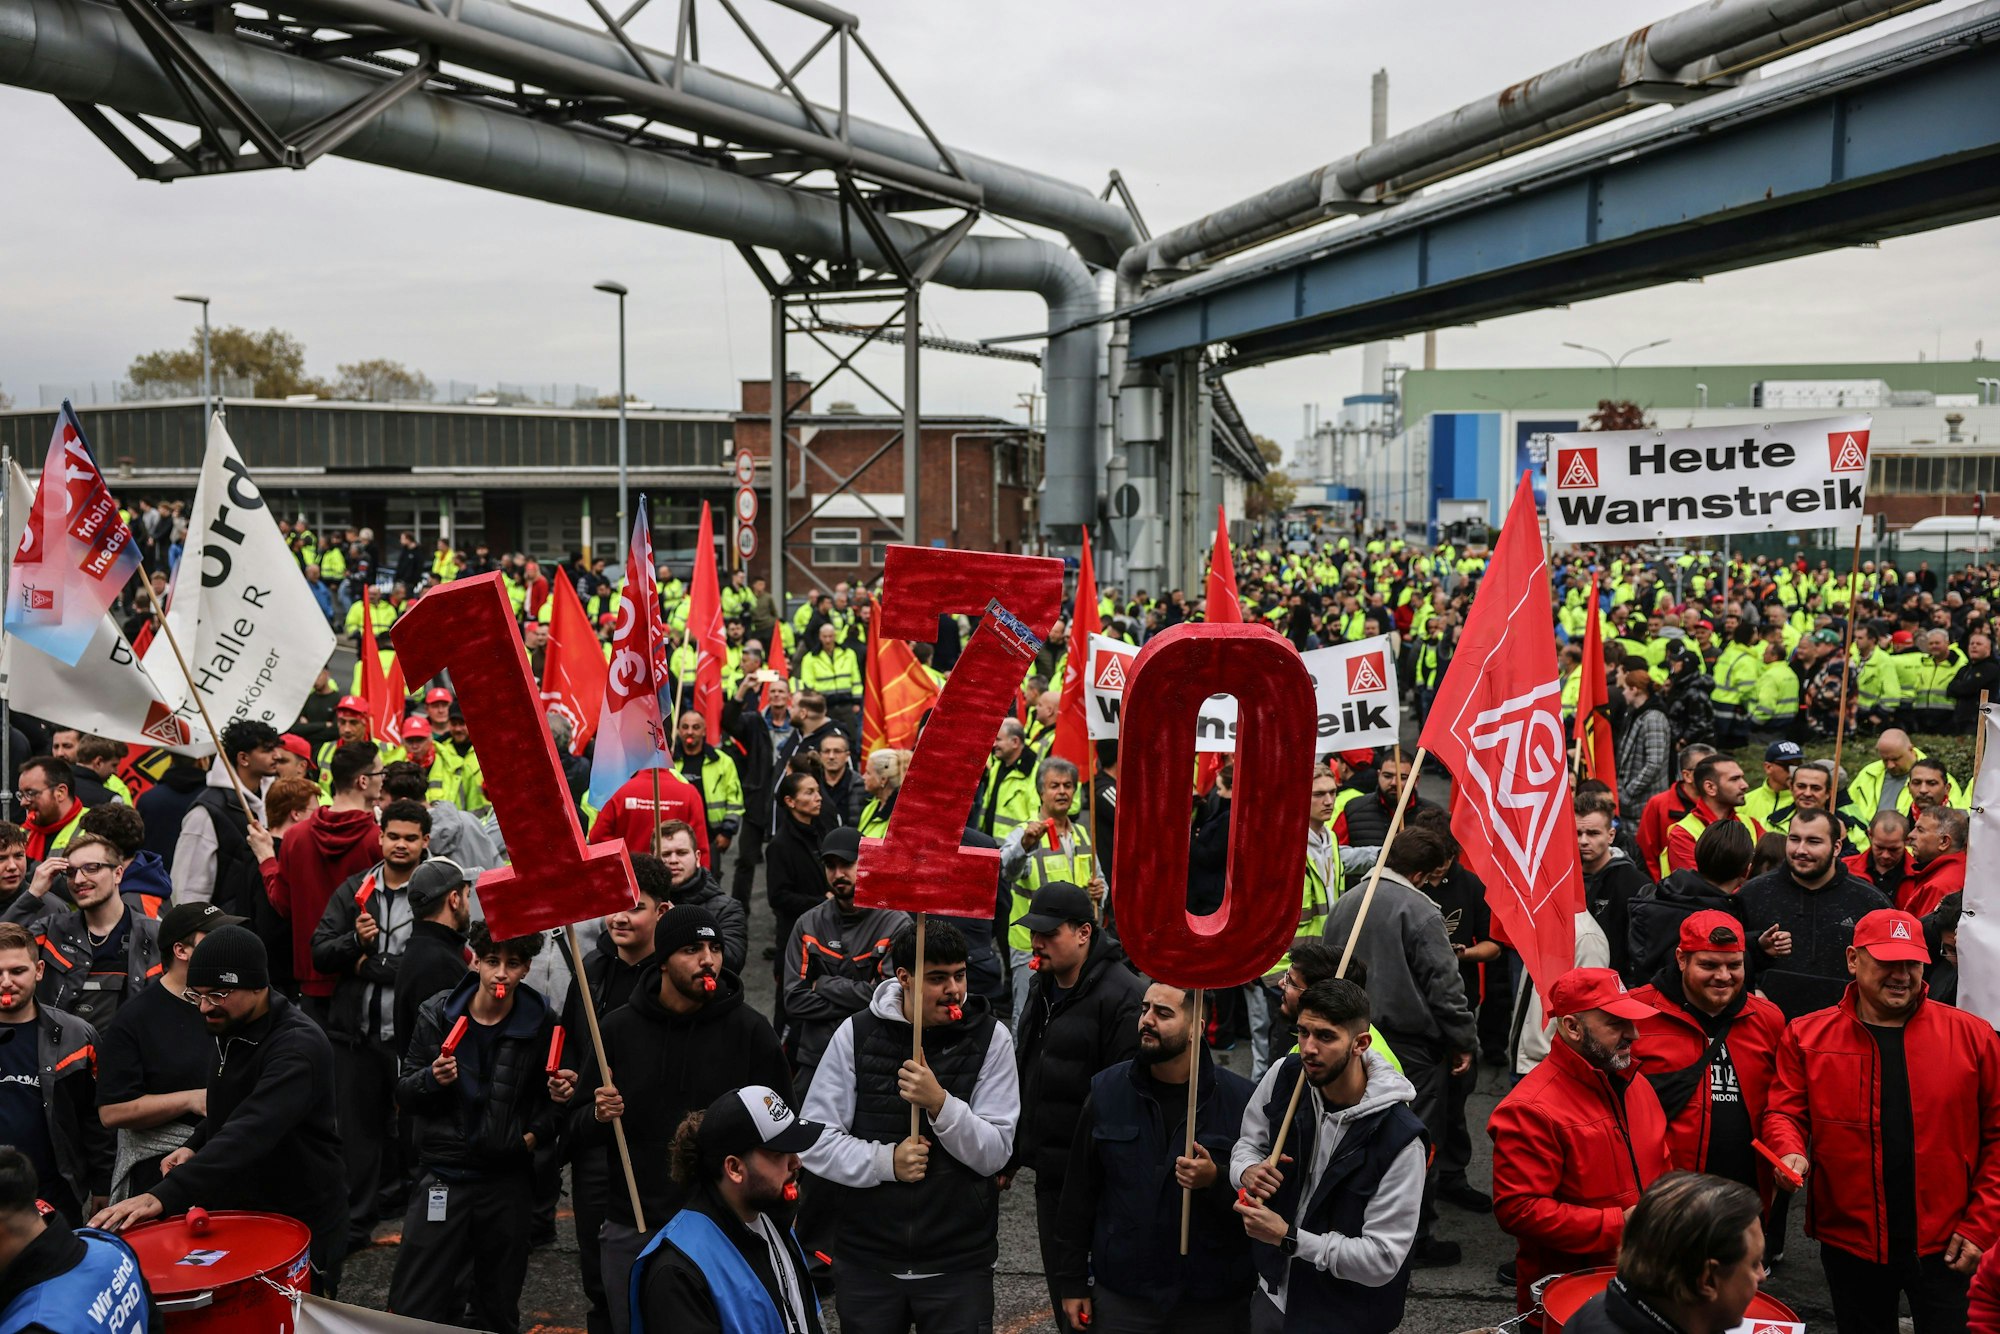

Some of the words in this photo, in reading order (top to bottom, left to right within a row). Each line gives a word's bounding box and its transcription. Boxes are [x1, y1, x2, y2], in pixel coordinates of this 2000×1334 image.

[1629, 439, 1796, 476] Heute
[1557, 479, 1863, 526] Warnstreik
[193, 617, 255, 695] Halle
[242, 585, 272, 609] R
[87, 1287, 113, 1324] Wir
[111, 1252, 134, 1295] sind
[108, 1282, 140, 1334] FORD
